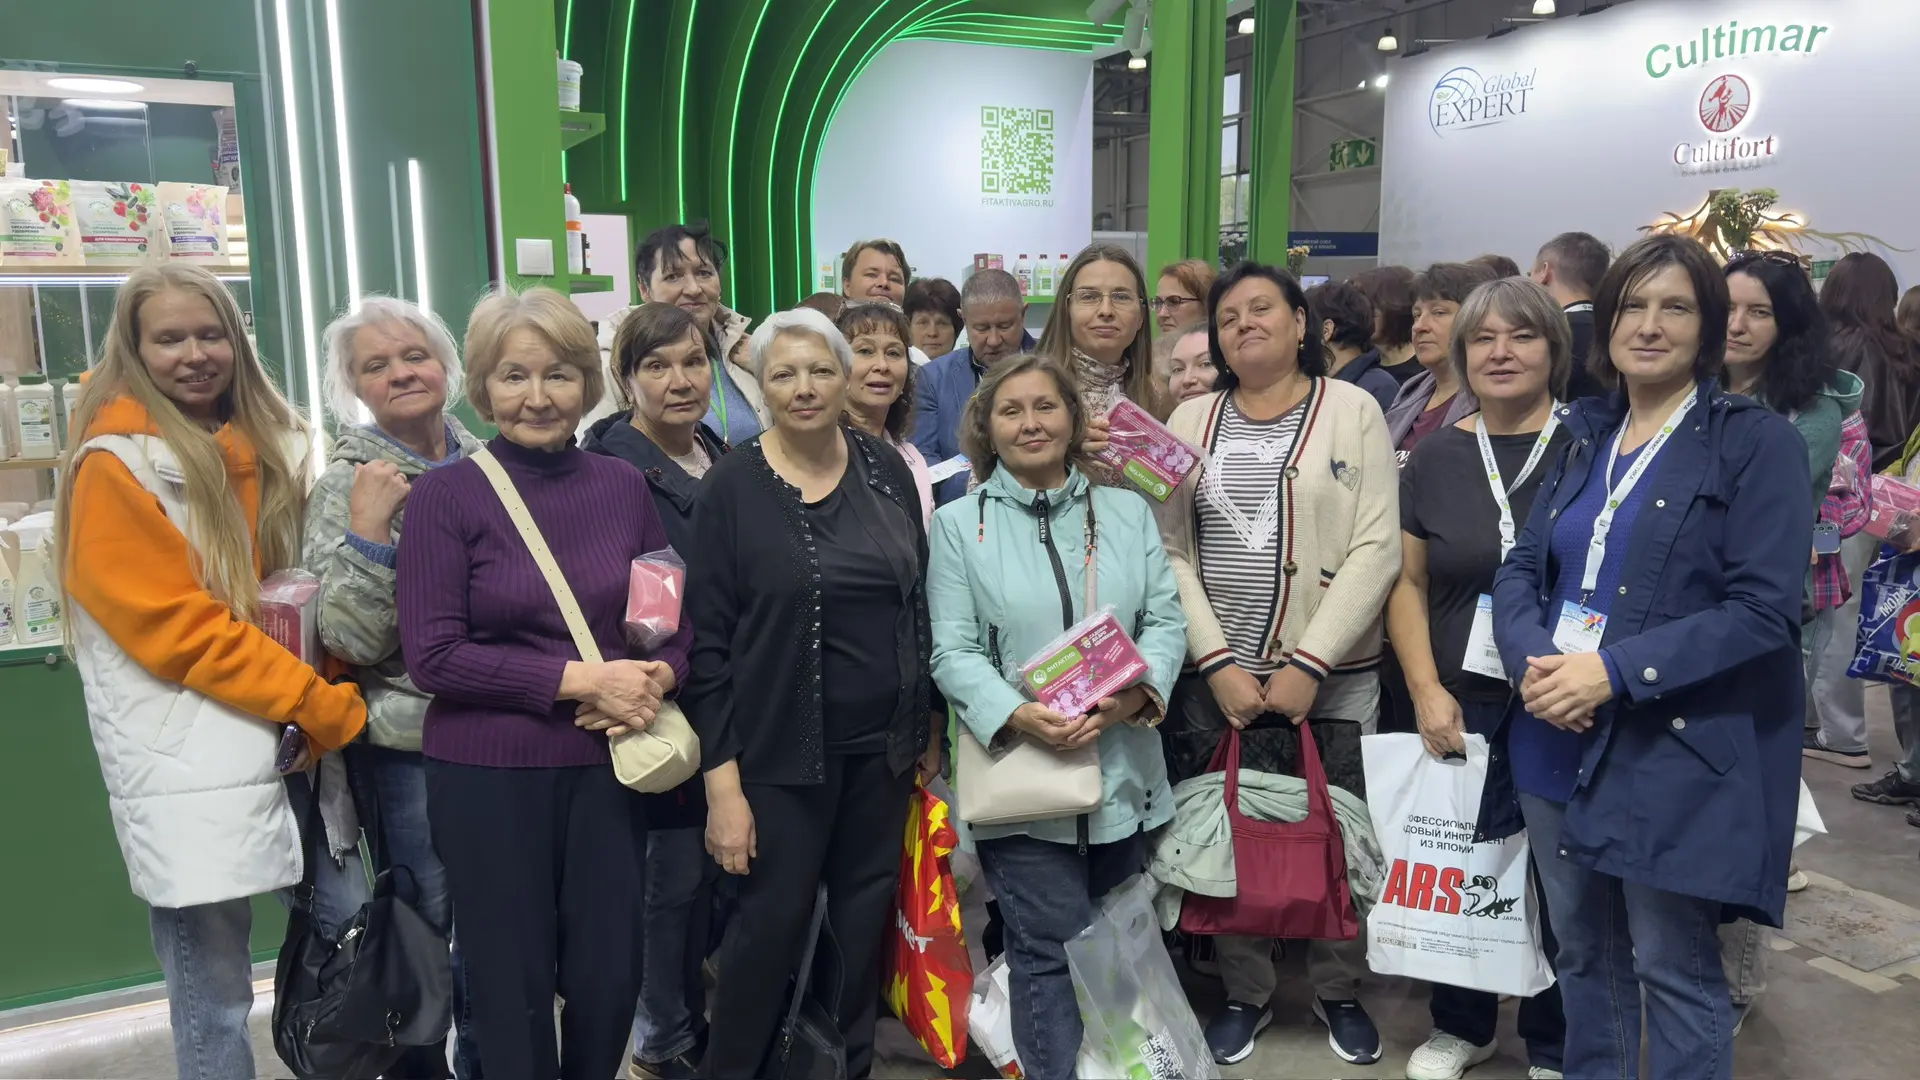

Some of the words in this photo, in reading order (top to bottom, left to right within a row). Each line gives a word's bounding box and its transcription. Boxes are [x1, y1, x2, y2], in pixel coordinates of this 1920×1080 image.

[1646, 20, 1828, 78] Cultimar
[1483, 67, 1537, 94] Global
[1436, 87, 1534, 127] EXPERT
[1673, 134, 1775, 165] Cultifort
[981, 197, 1054, 207] FITAKTIVAGRO.RU
[1880, 587, 1911, 617] МОДА
[1046, 651, 1076, 673] ФИТАКТИВ
[1407, 814, 1477, 831] ОФЕССИОАЛЬ
[1420, 839, 1434, 849] ИЗ
[1381, 858, 1465, 916] ARS
